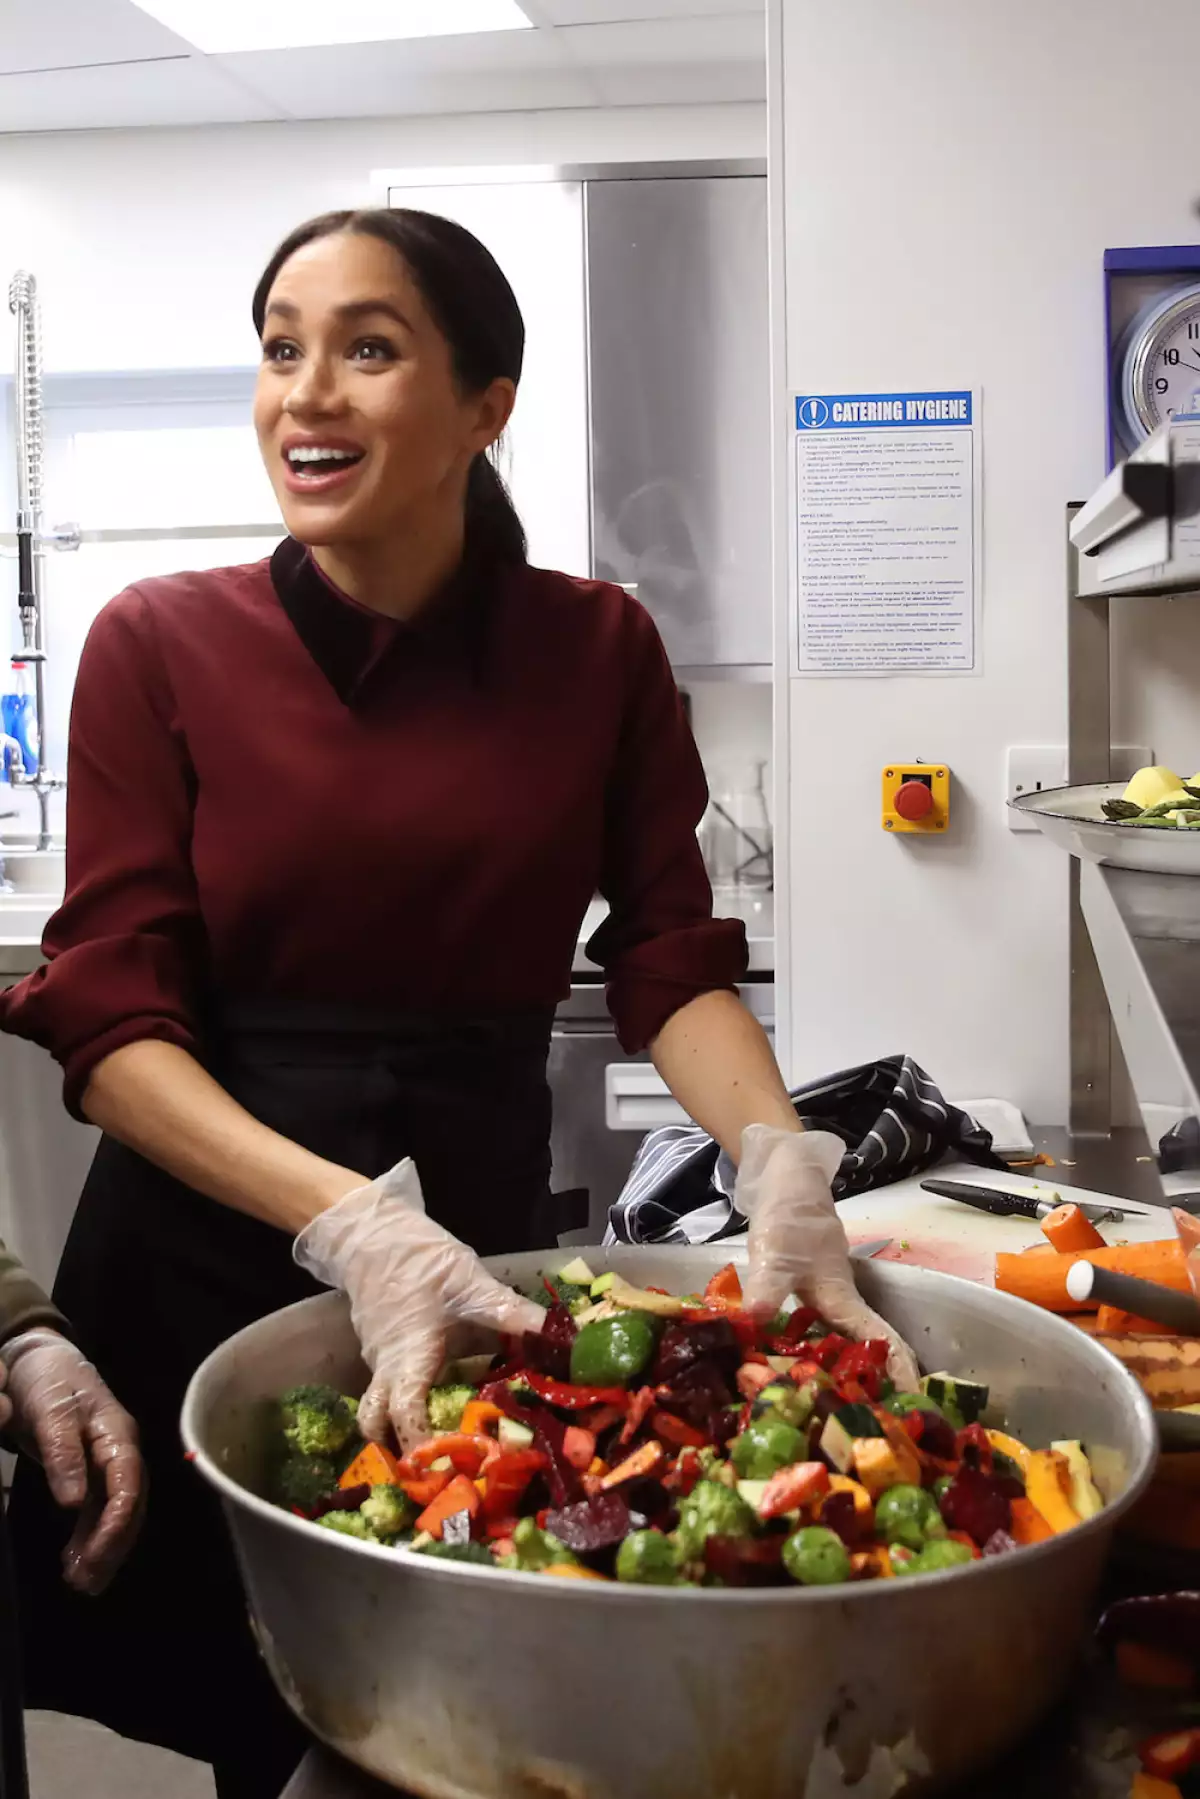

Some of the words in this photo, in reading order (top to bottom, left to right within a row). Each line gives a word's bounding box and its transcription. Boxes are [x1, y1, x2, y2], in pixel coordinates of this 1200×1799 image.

[1188, 323, 1199, 339] 11
[1164, 348, 1180, 365] 10
[1155, 377, 1169, 394] 9
[832, 401, 903, 421] CATERING
[906, 399, 967, 421] HYGIENE
